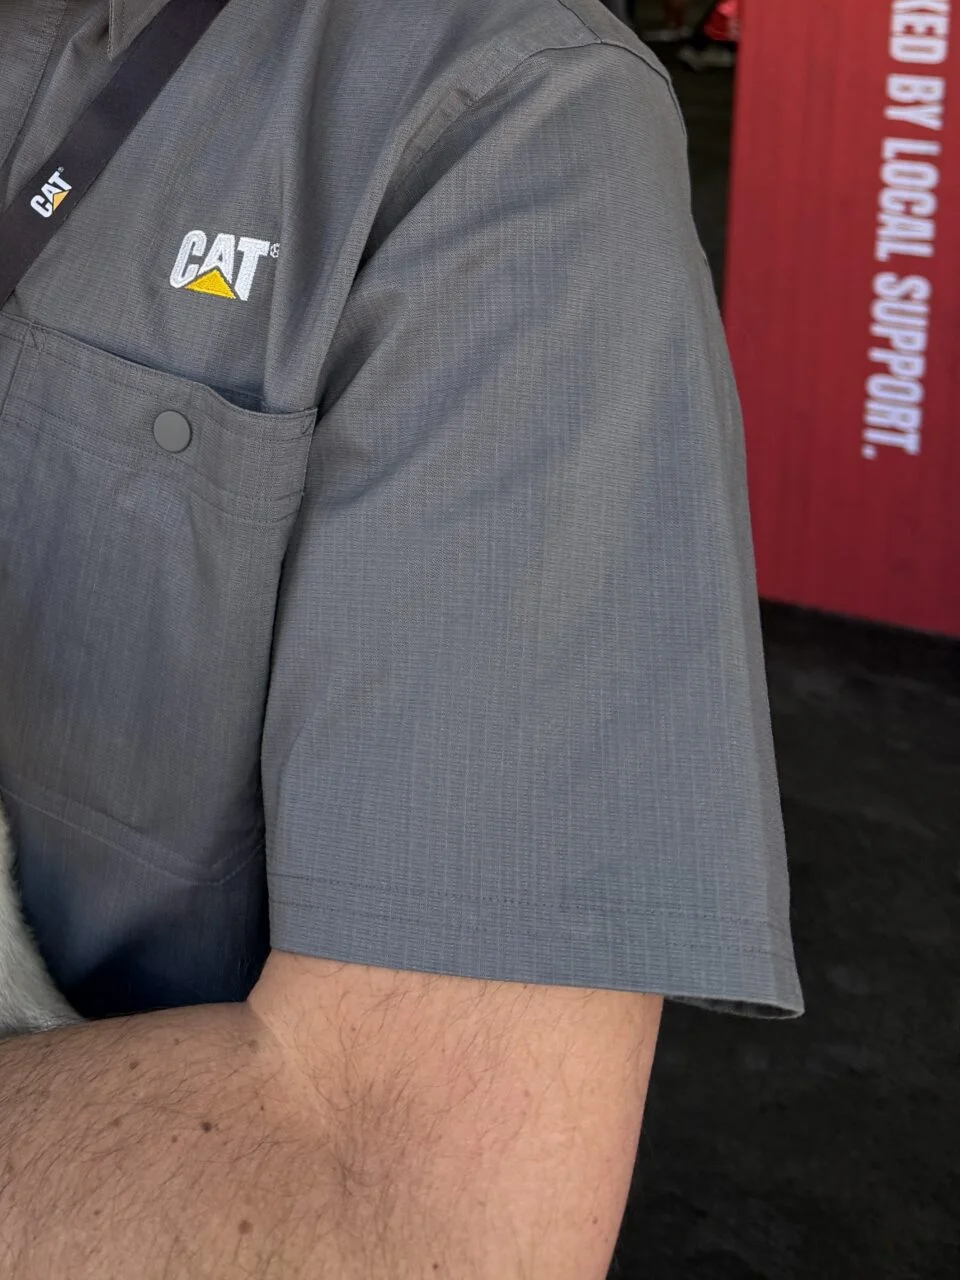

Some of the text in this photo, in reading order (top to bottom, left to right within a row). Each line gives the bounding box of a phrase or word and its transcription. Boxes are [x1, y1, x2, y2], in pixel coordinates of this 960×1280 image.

[884, 72, 945, 132] BY
[29, 170, 73, 218] CAT
[875, 136, 941, 262] LOCAL
[861, 271, 932, 461] SUPPORT.
